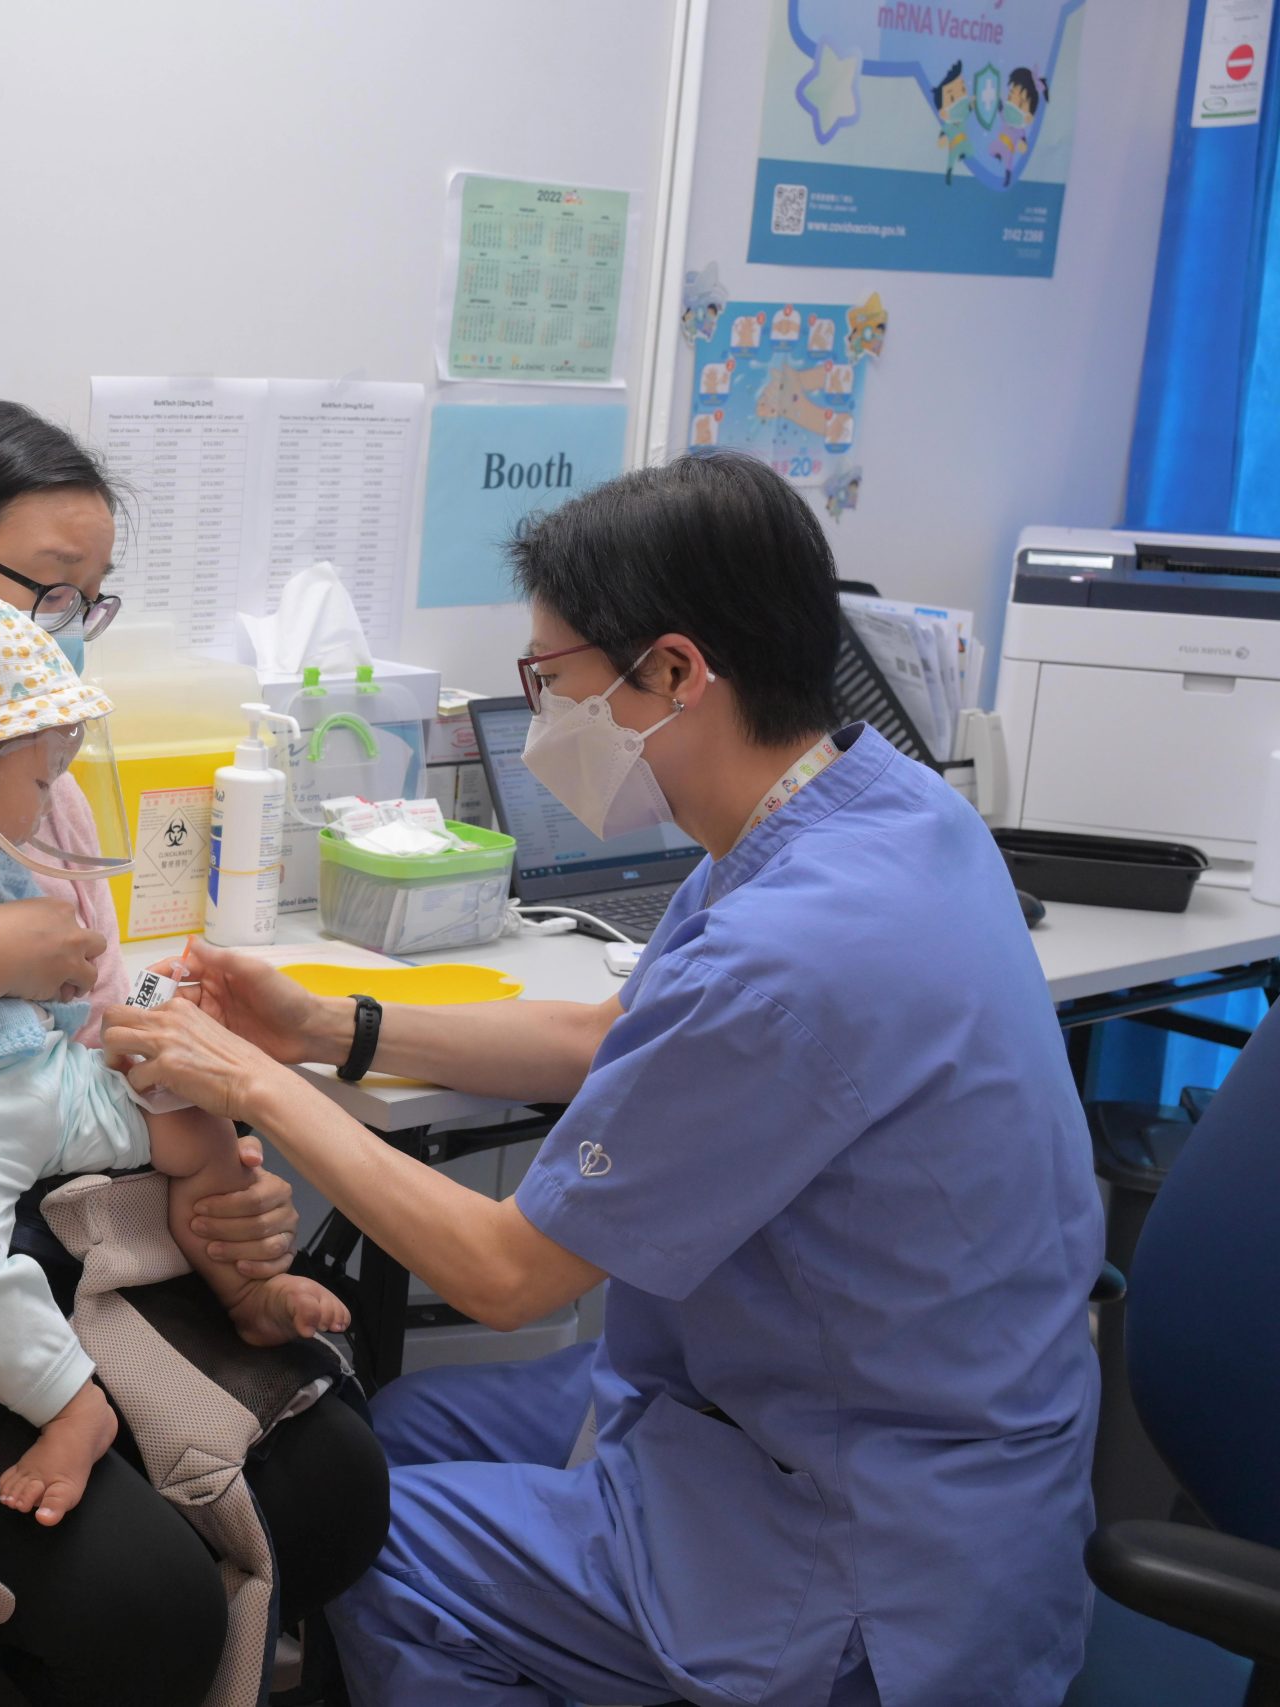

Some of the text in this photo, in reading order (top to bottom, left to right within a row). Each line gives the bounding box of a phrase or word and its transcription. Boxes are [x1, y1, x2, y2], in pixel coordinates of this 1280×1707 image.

[878, 1, 1004, 45] mRNA Vaccine
[537, 190, 562, 203] 2022
[482, 452, 572, 490] Booth
